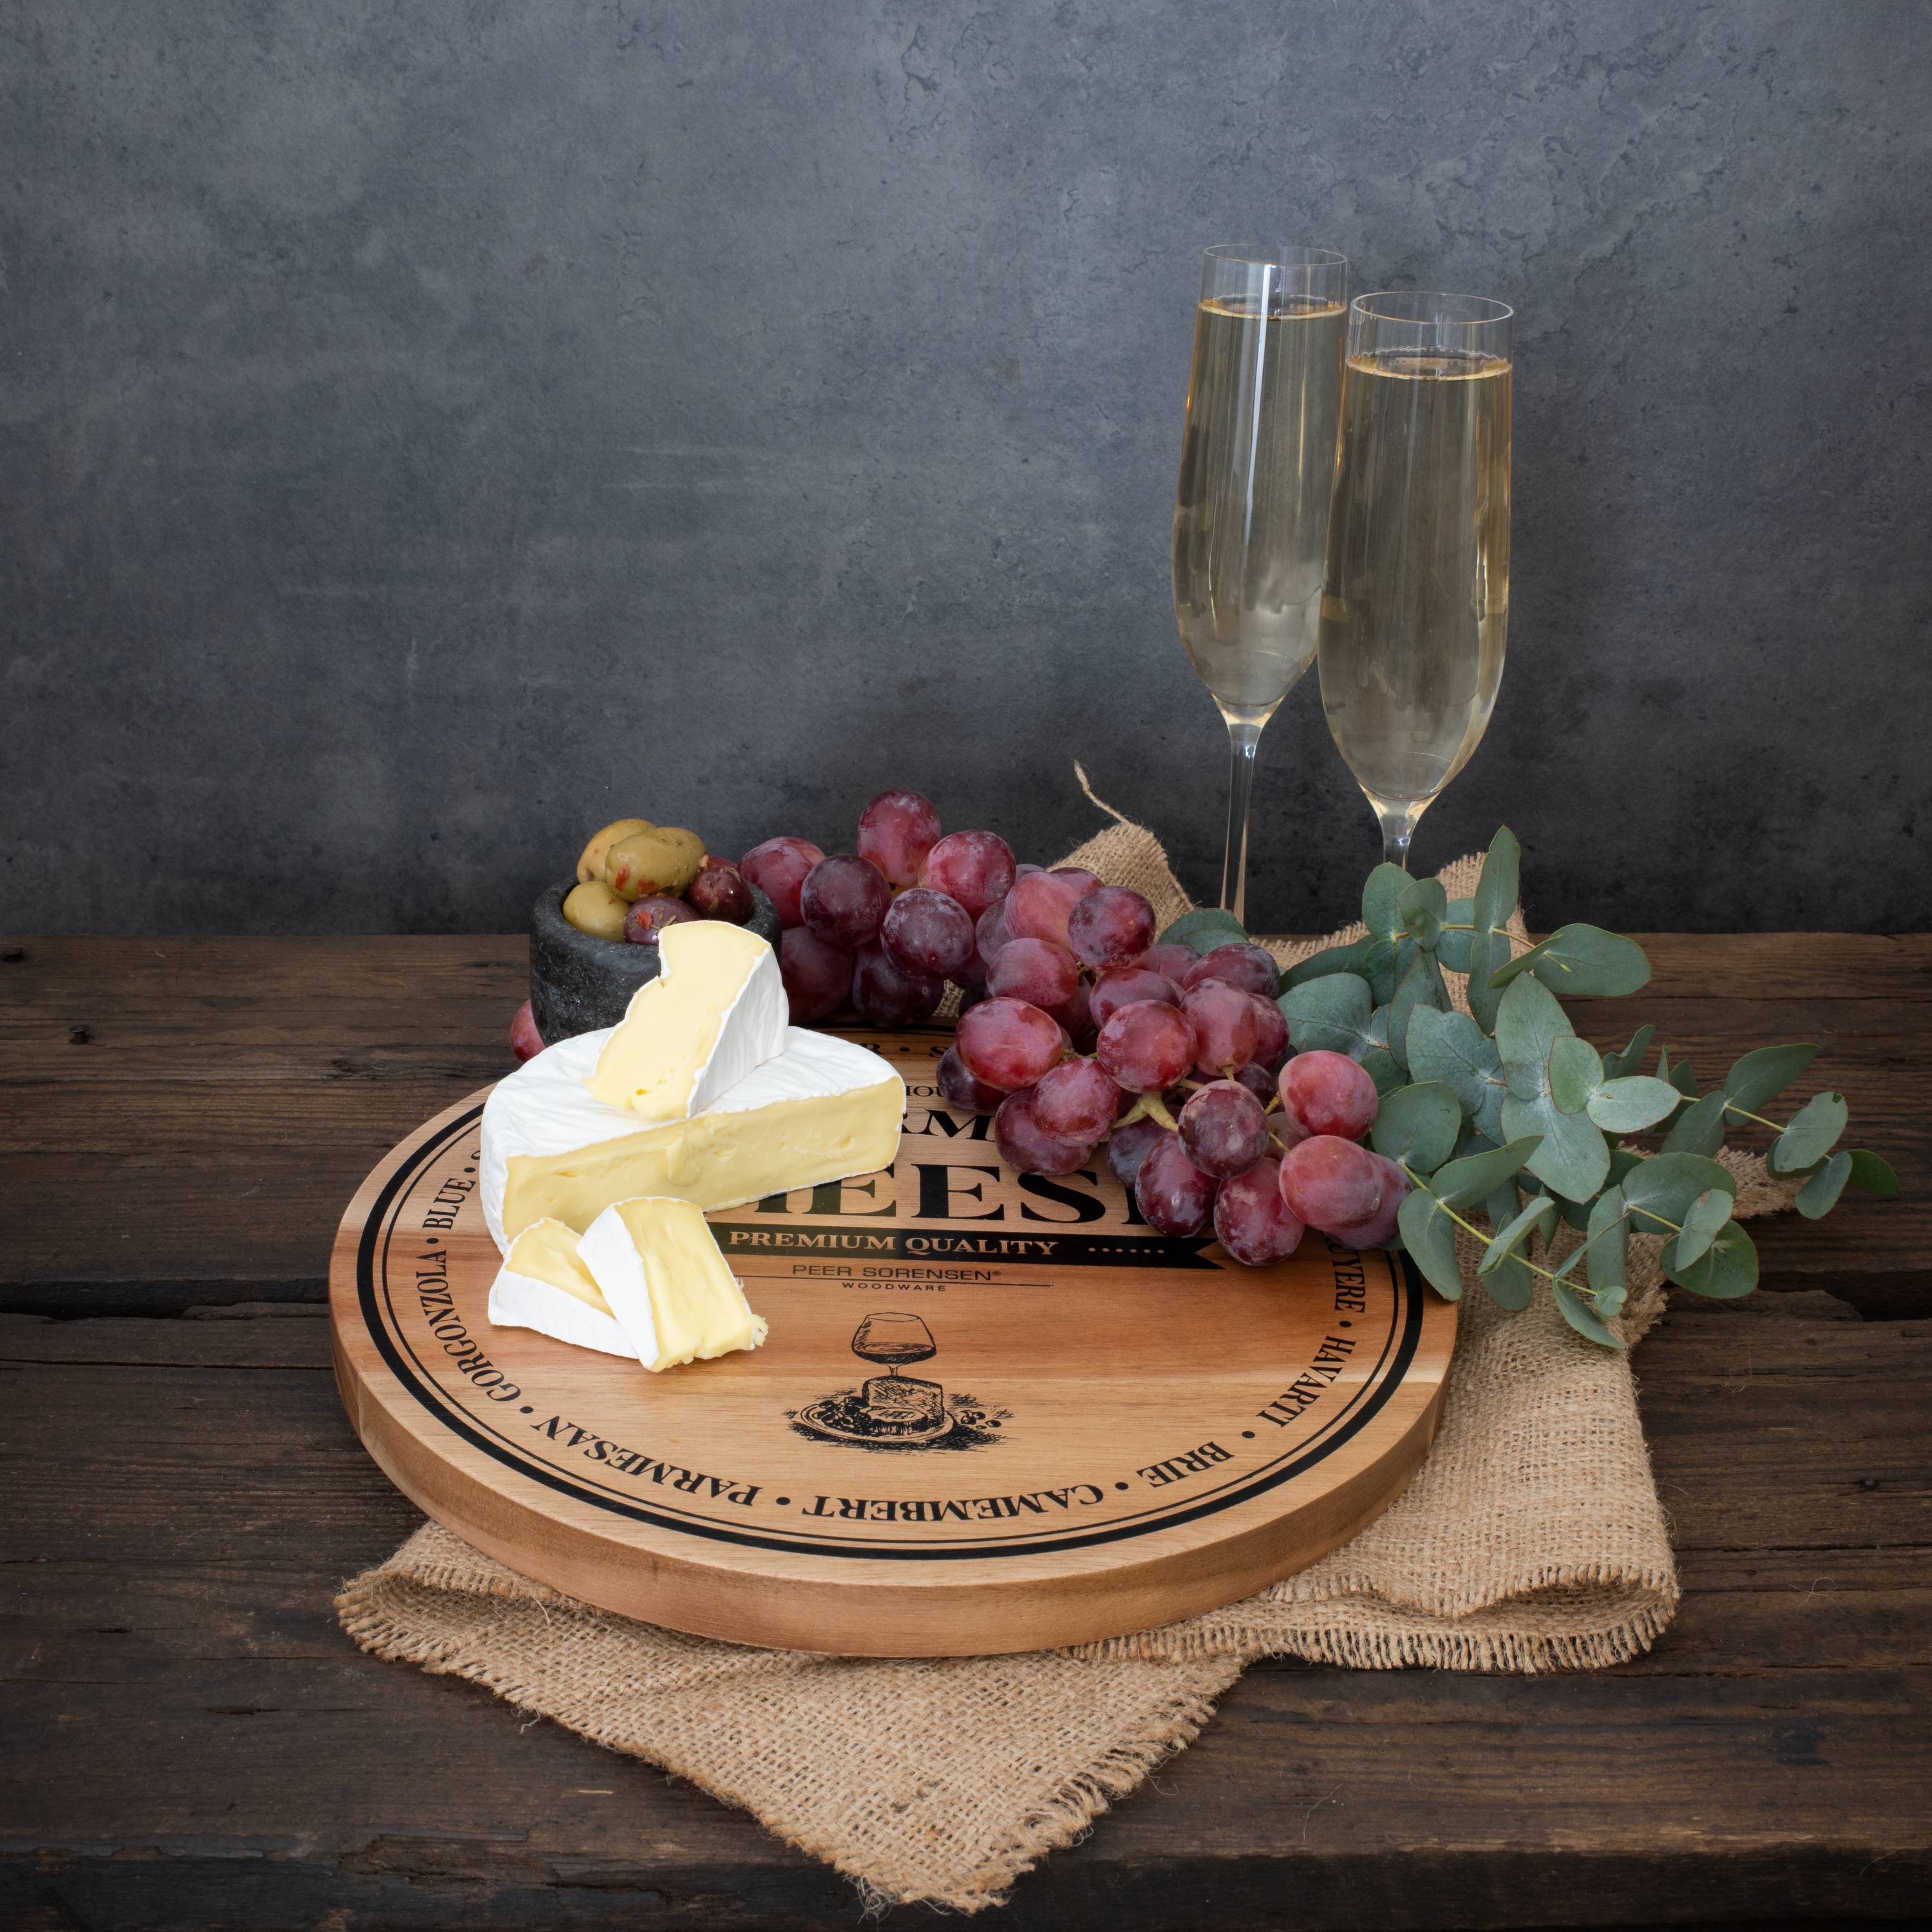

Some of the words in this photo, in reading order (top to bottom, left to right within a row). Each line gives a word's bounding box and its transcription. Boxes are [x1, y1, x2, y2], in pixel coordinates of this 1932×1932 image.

[422, 1178, 477, 1230] BLUE
[754, 1163, 1148, 1226] EES
[728, 1231, 896, 1251] PREMIUM
[905, 1237, 1059, 1256] QUALITY
[792, 1264, 852, 1277] PEER
[841, 1282, 947, 1292] WOODWARE
[1322, 1232, 1366, 1313] UYERE
[417, 1249, 521, 1402] GORGONZOLA
[1256, 1335, 1356, 1428] HAVARTI
[531, 1416, 763, 1506] PARMESAN
[1137, 1441, 1235, 1488] BRIE
[802, 1484, 1104, 1522] CAMEMBERT
